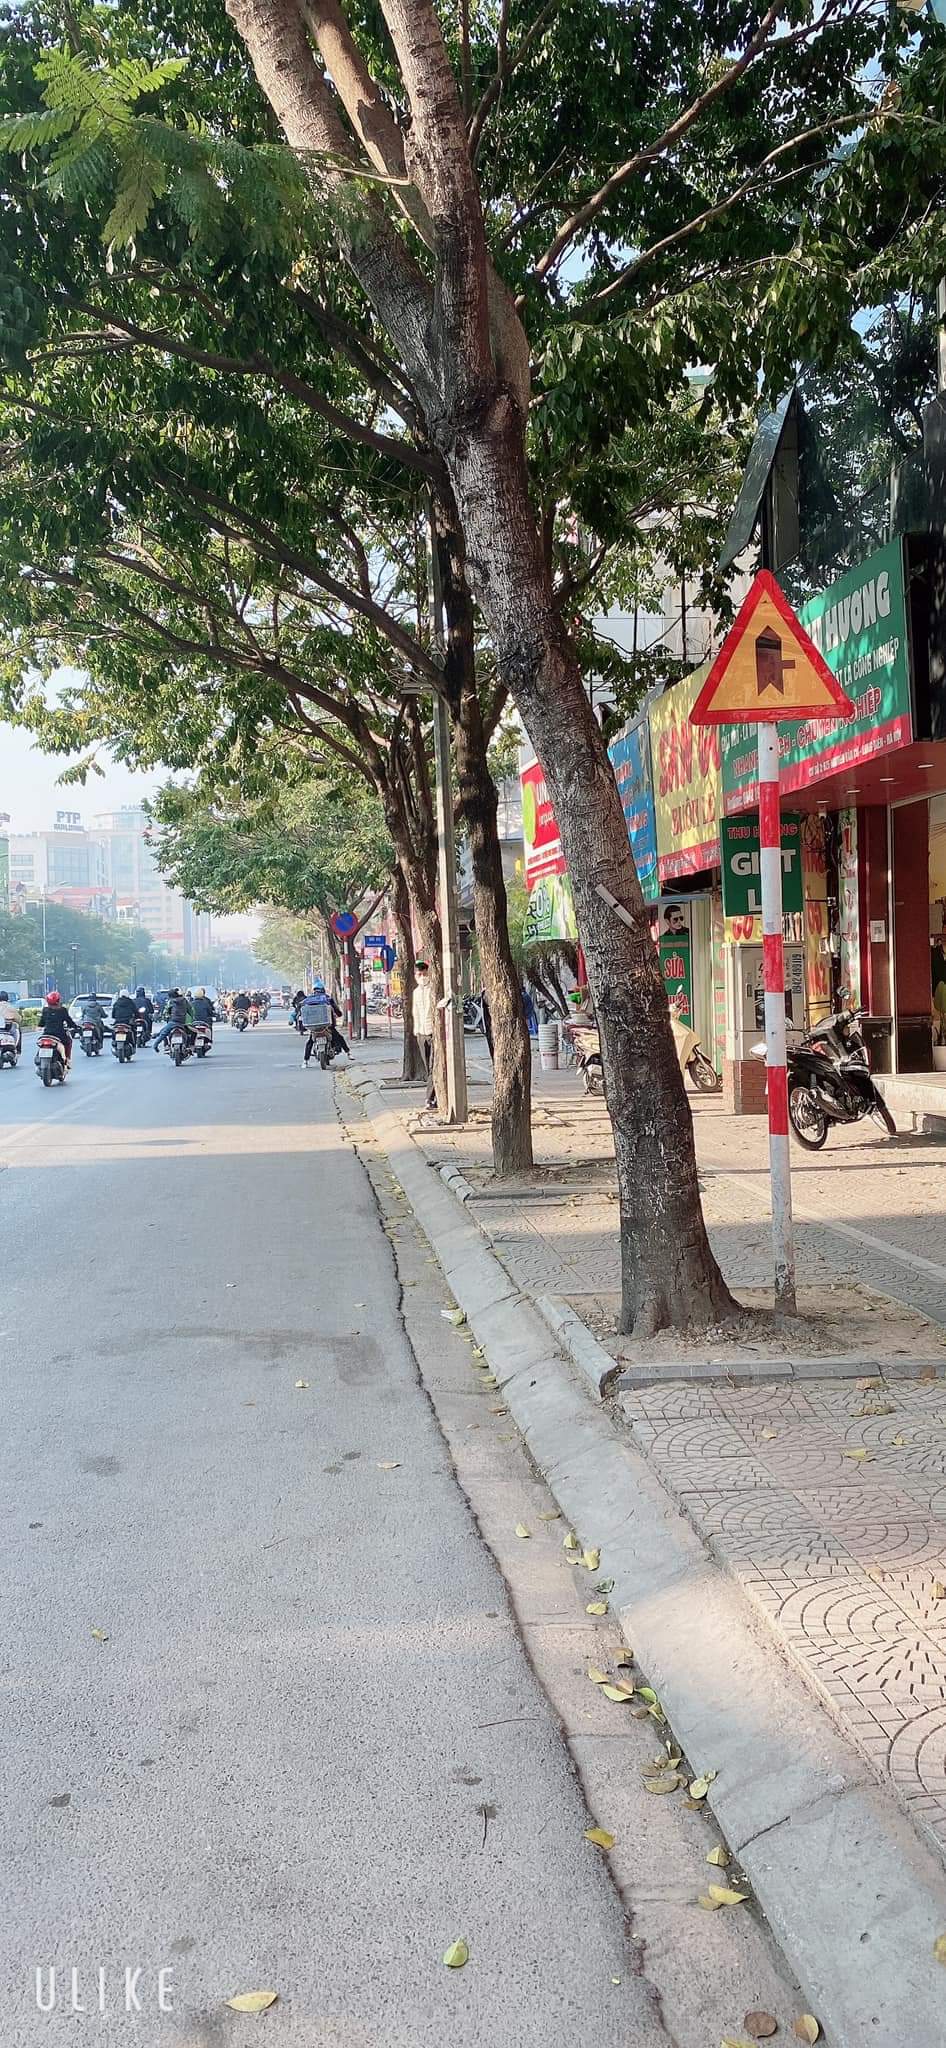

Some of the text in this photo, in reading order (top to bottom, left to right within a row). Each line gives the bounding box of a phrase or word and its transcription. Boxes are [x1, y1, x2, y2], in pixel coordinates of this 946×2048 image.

[56, 810, 80, 824] PTP
[727, 823, 798, 840] THU HNG
[730, 848, 797, 876] GIT
